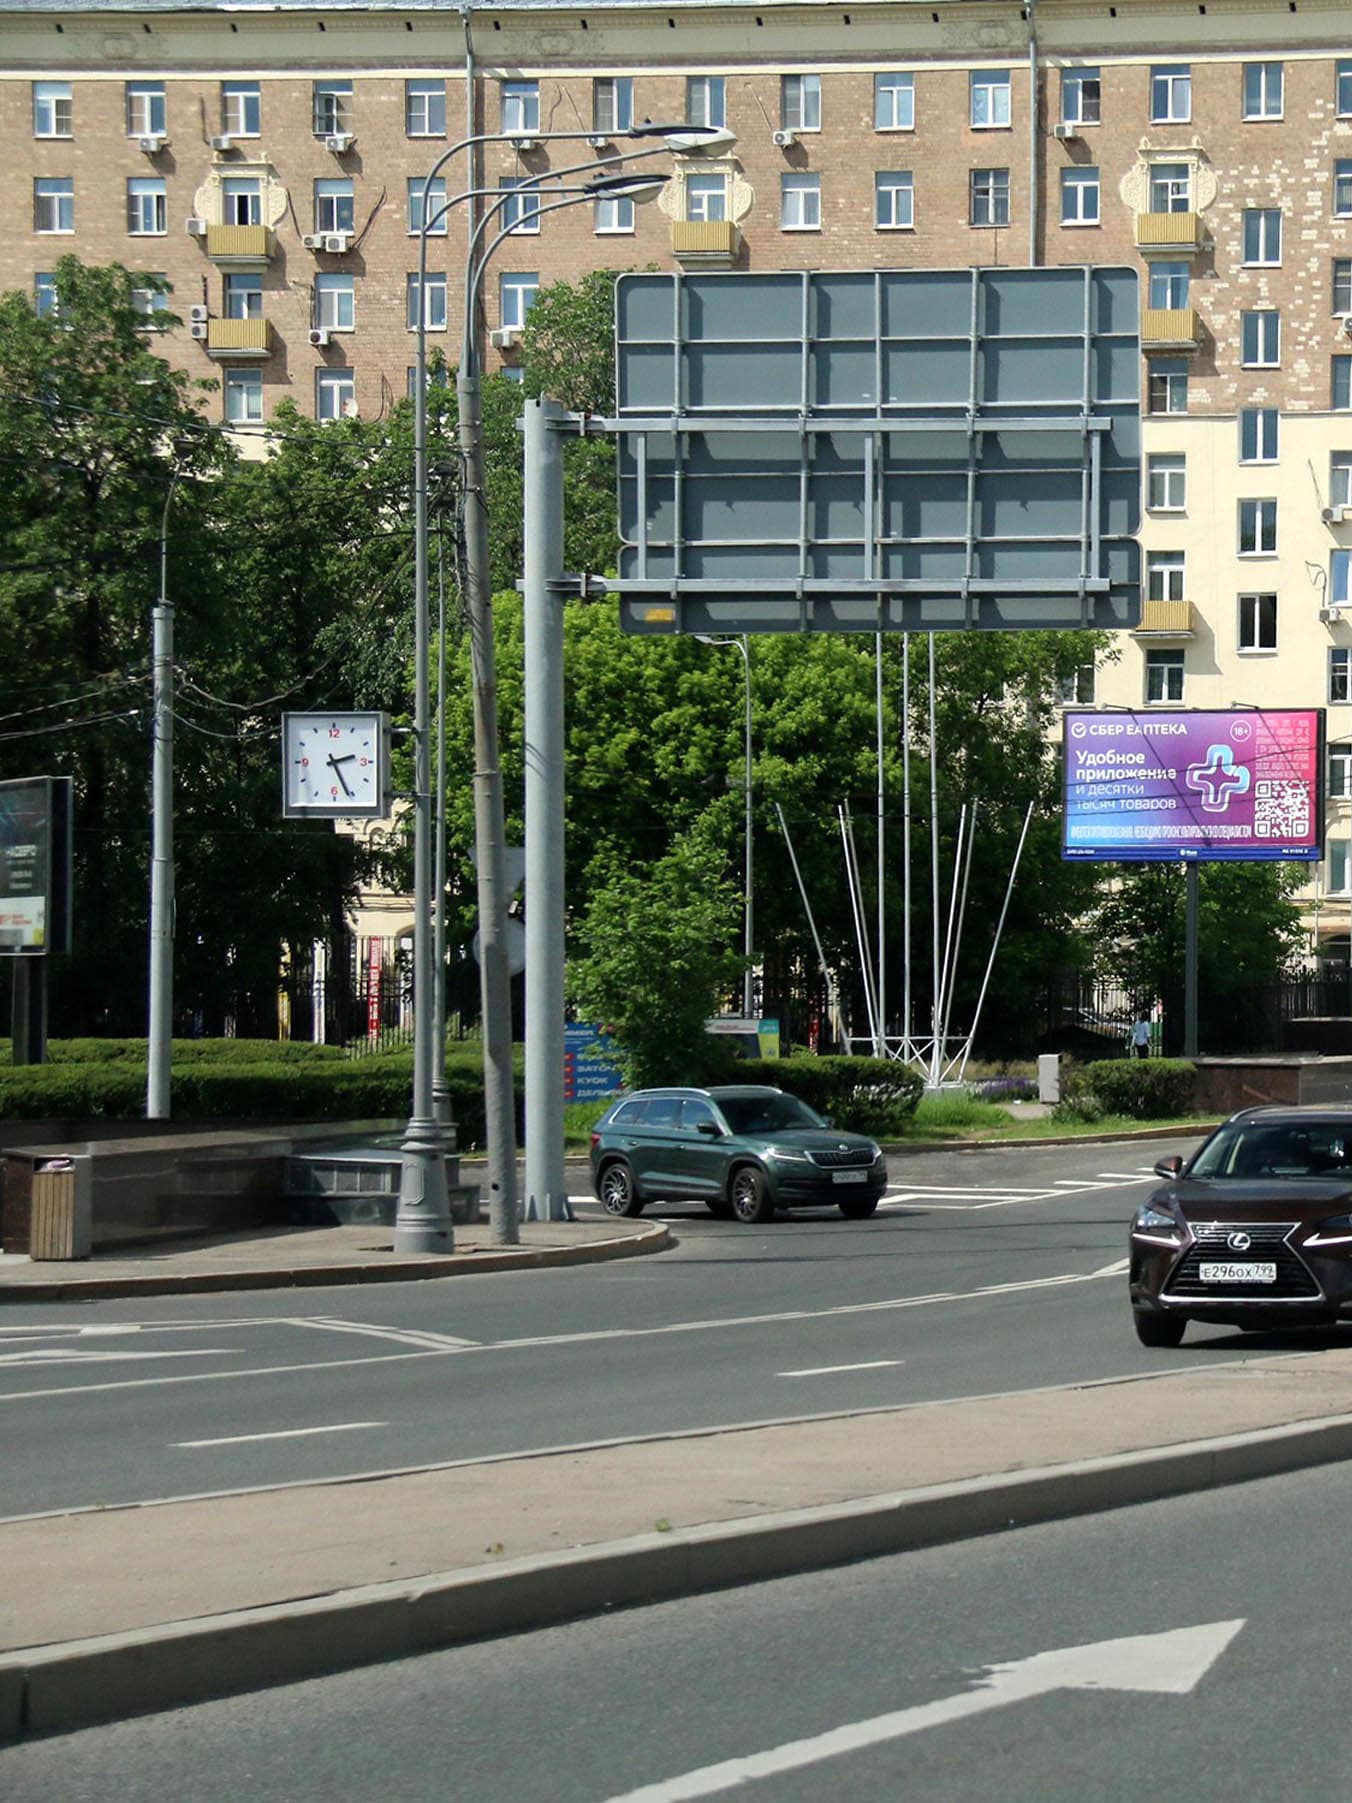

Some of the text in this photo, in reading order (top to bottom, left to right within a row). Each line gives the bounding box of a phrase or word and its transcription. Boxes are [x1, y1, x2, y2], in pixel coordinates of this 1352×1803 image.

[329, 728, 340, 738] 12
[1089, 724, 1188, 735] СБЕР ЕАПТЕКА
[301, 757, 309, 767] 9
[360, 757, 367, 767] 3
[1076, 750, 1145, 766] Удобное
[1076, 768, 1177, 782] приложение
[331, 786, 338, 796] 6
[1076, 784, 1144, 796] и десятки
[1120, 799, 1177, 810] товаров
